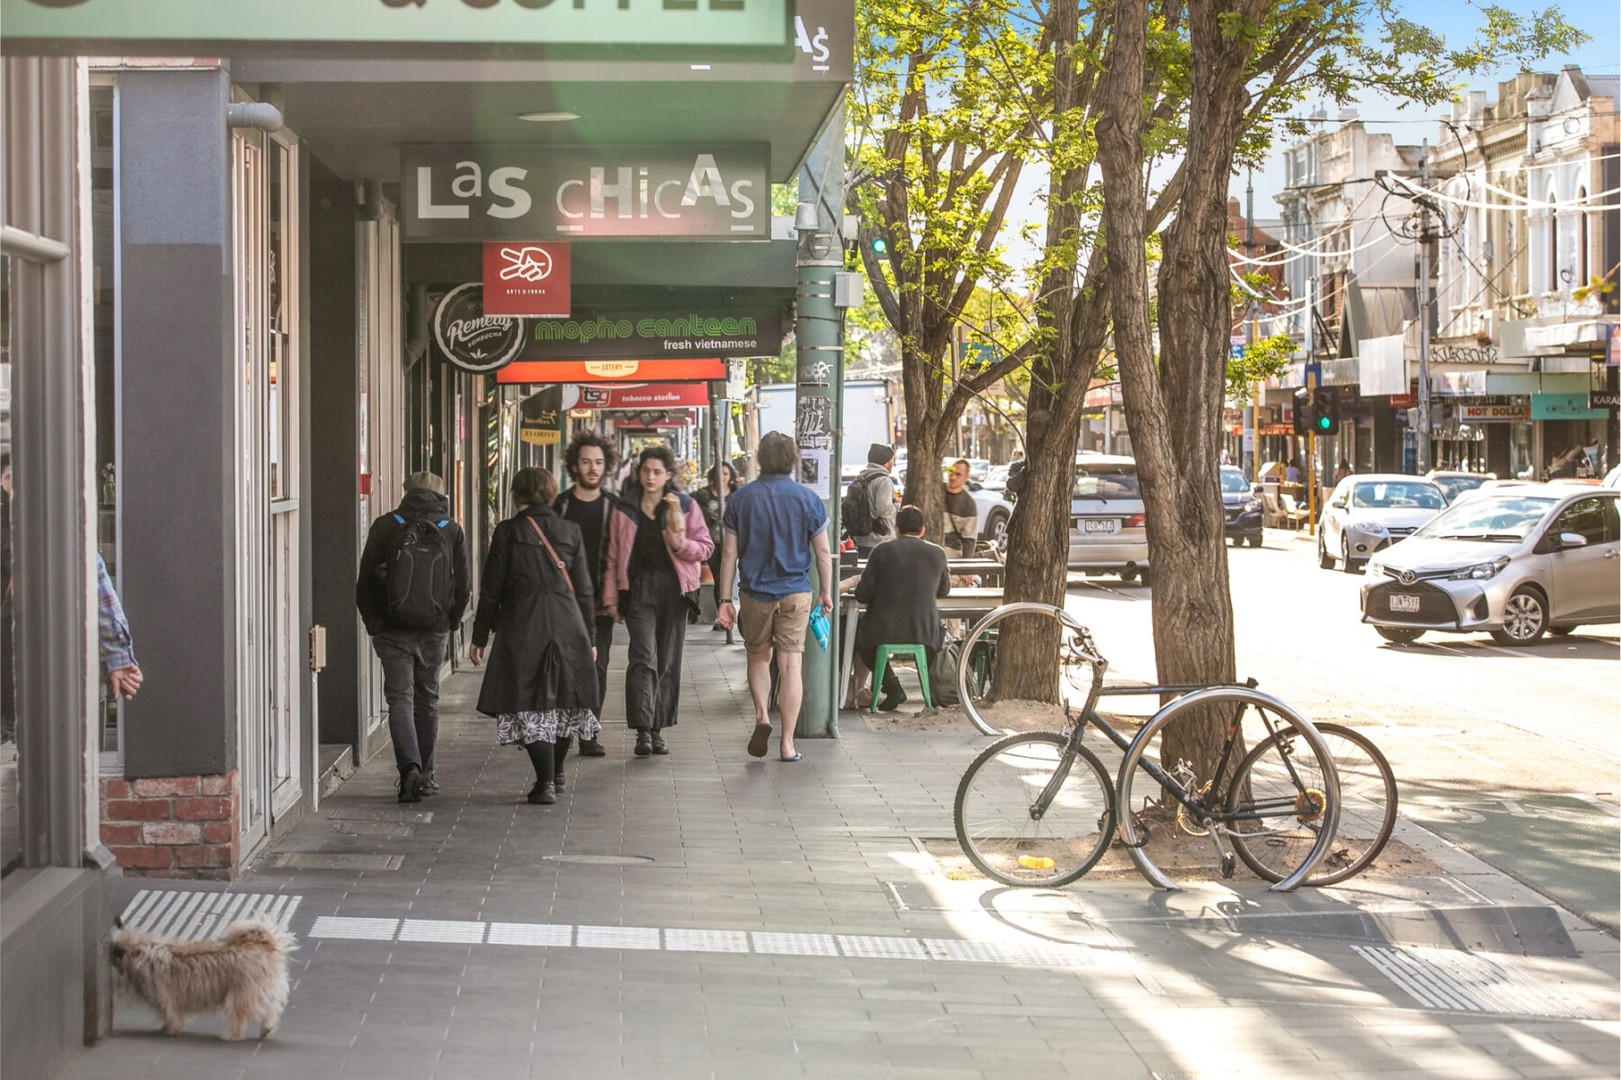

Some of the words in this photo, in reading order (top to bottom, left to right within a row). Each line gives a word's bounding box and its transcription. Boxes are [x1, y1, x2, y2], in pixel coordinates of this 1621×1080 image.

[535, 316, 633, 343] mopho
[637, 313, 757, 338] canteen
[664, 339, 692, 350] fresh
[695, 339, 757, 350] vietnamese
[653, 392, 680, 401] station
[1467, 408, 1487, 416] HOT
